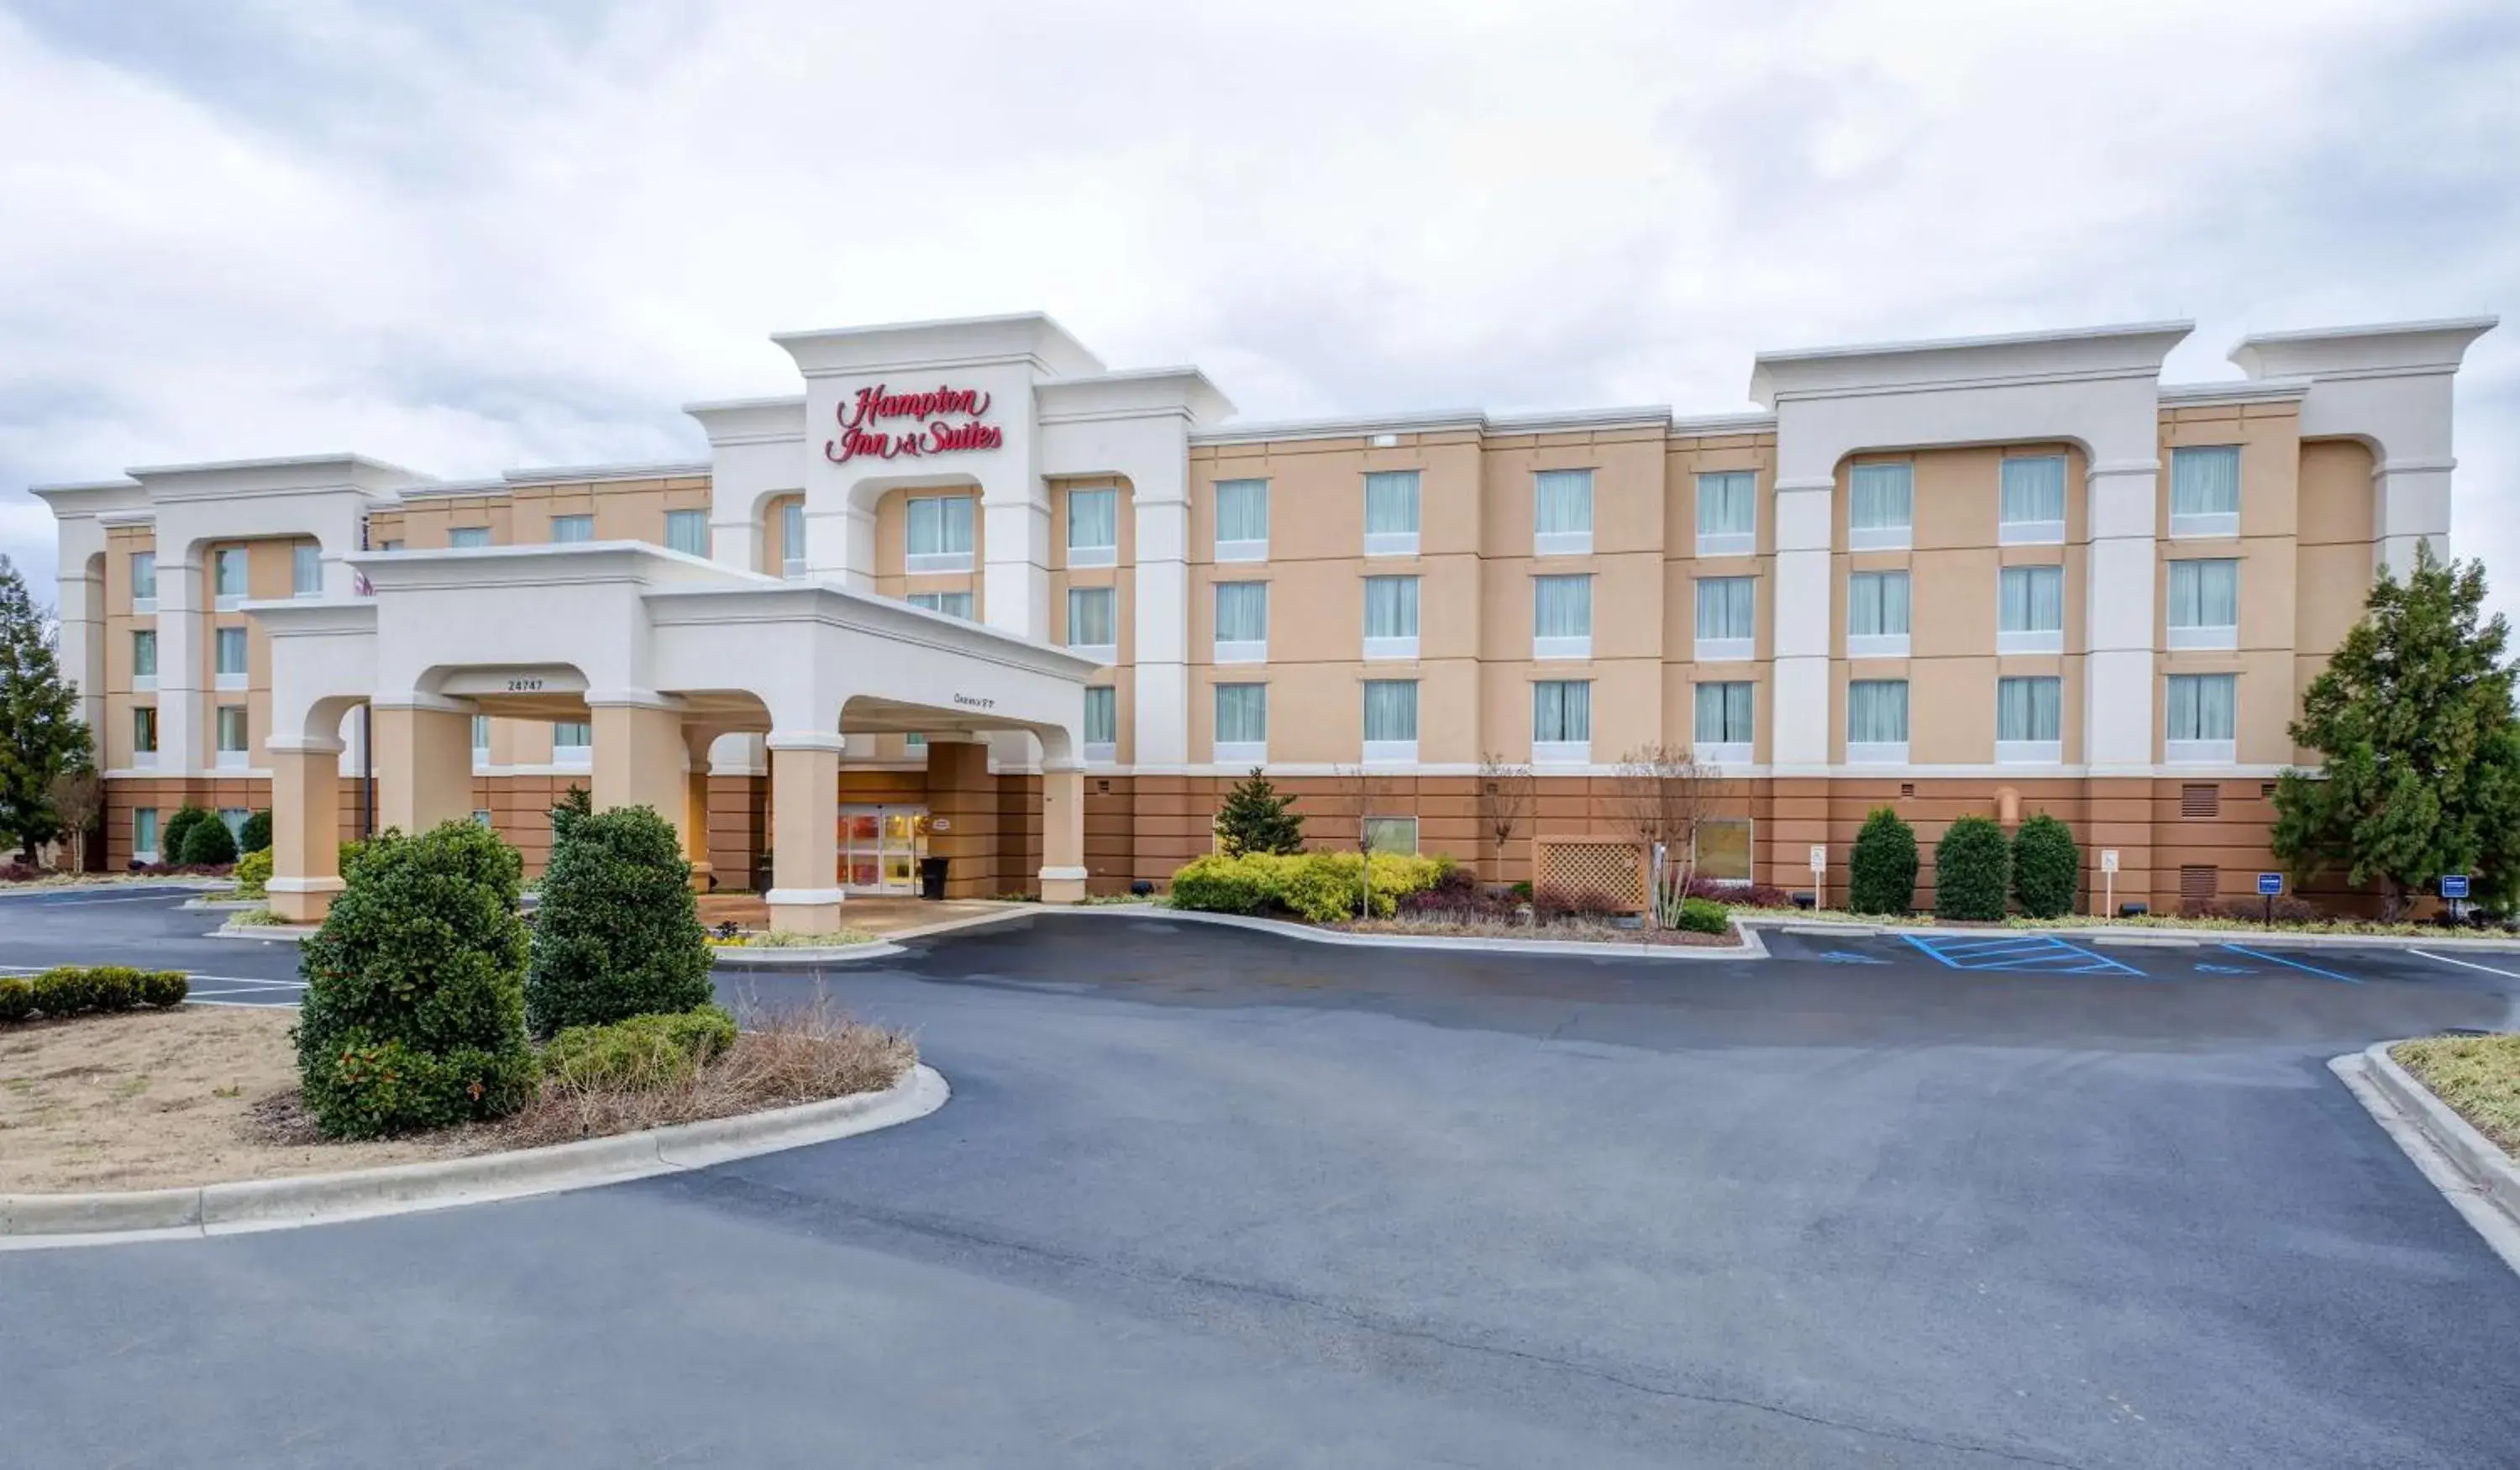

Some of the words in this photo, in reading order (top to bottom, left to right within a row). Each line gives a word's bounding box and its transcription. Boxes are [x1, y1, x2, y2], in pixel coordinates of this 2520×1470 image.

[837, 384, 990, 428] Hampton
[826, 427, 902, 463] Inn
[900, 432, 921, 457] &
[919, 421, 1002, 454] Suites
[508, 680, 543, 690] 24747
